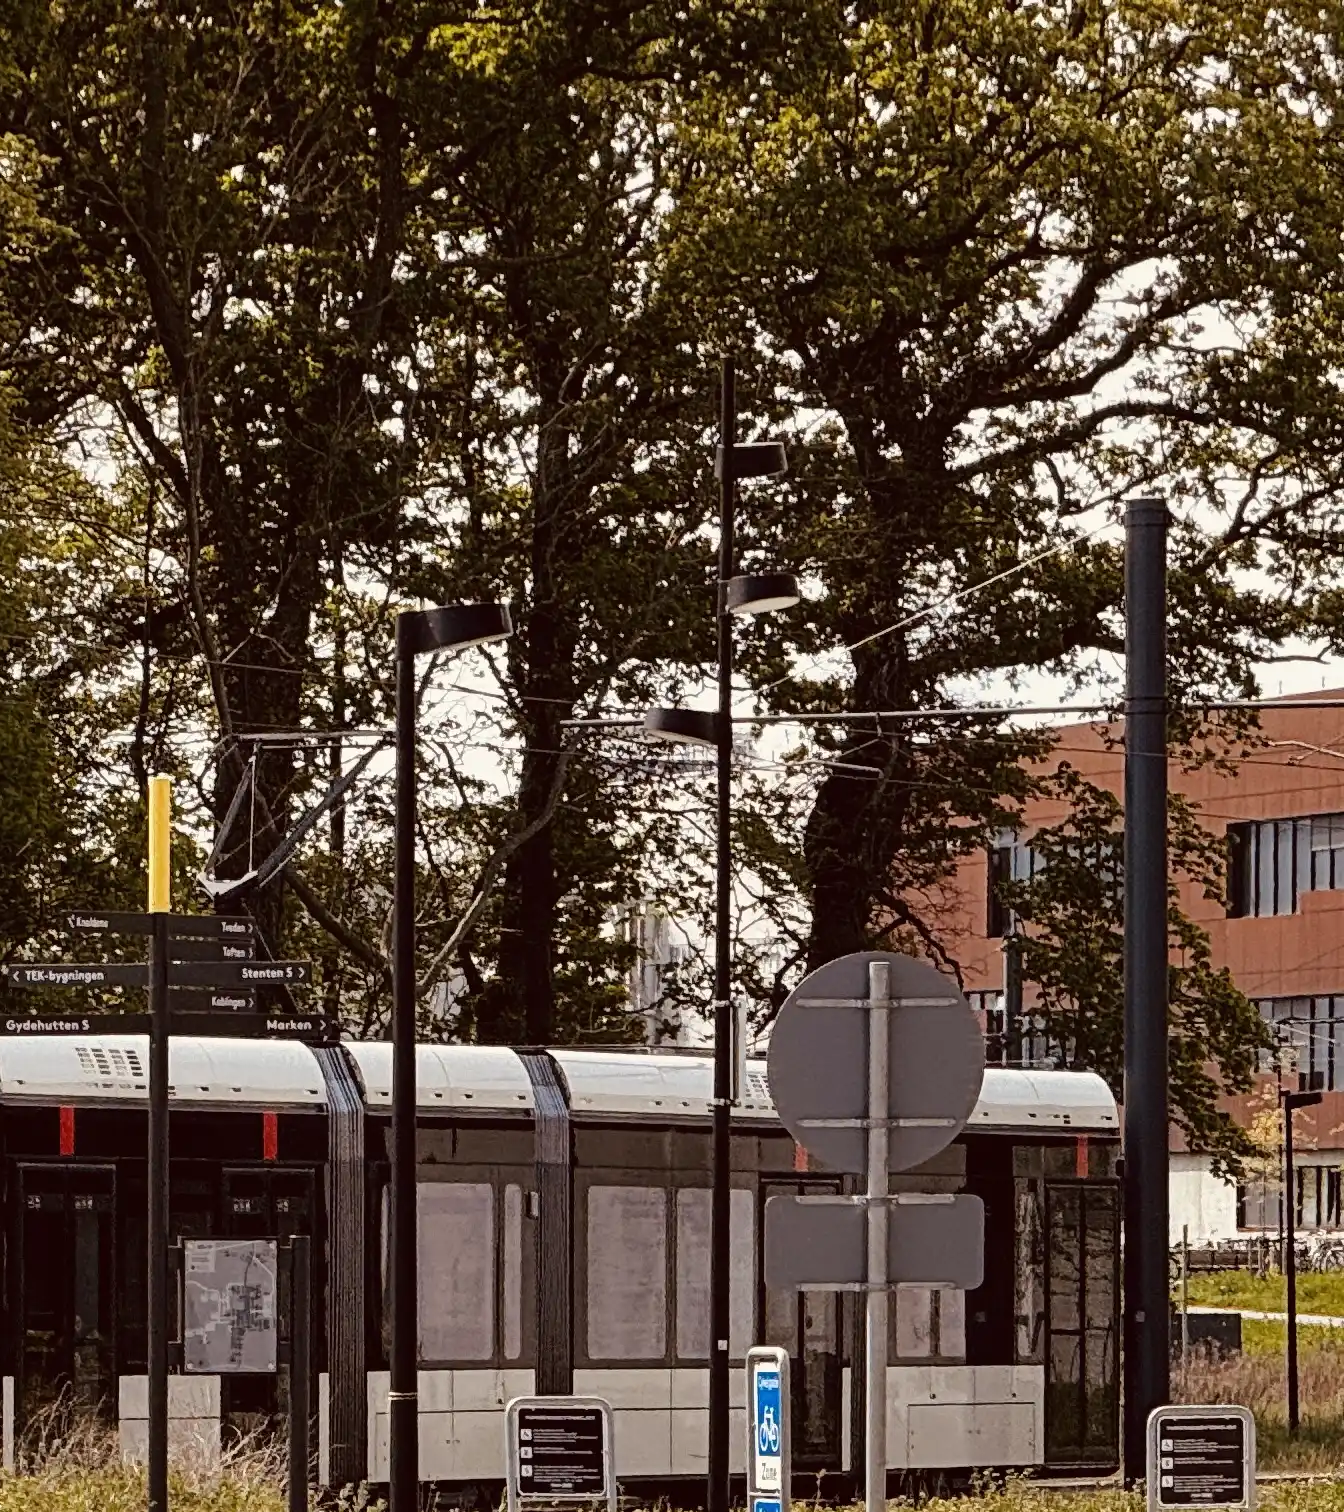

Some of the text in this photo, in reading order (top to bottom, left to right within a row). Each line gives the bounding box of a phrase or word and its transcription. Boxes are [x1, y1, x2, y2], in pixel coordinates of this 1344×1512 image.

[25, 969, 104, 984] TEK-bygningen
[242, 965, 294, 979] Stenten S
[6, 1019, 90, 1033] Gydehutten S
[266, 1019, 312, 1031] Marken
